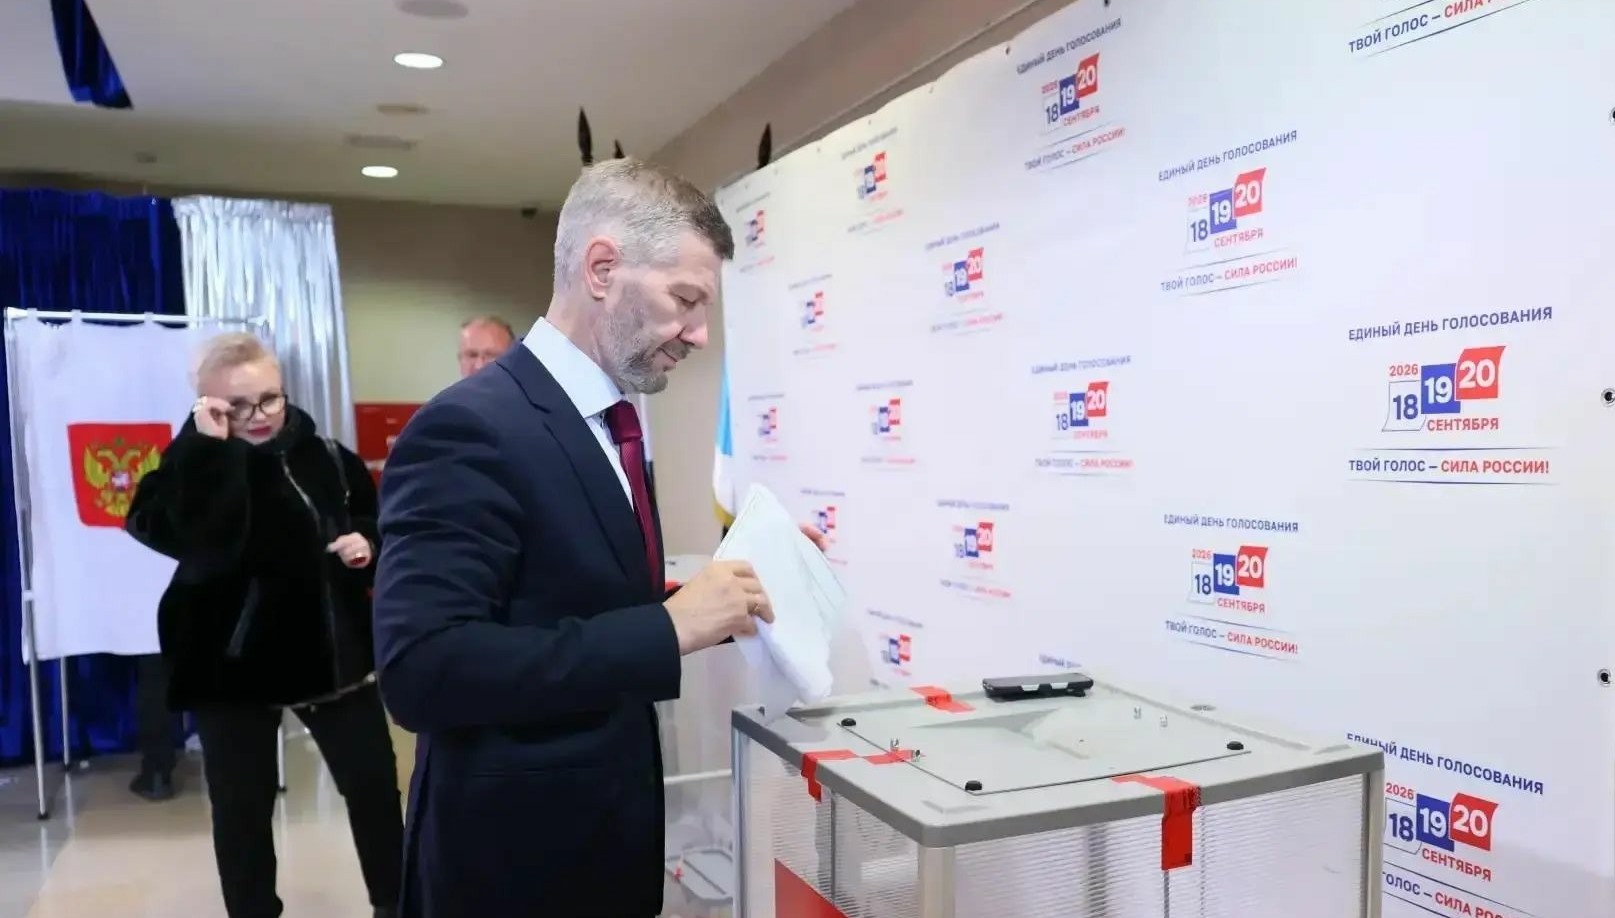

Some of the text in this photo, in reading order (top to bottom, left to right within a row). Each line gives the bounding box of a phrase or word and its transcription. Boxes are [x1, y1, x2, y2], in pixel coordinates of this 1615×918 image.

[1046, 46, 1066, 62] ДЕНЬ
[1066, 18, 1122, 52] ГОЛОСОВАНИЯ
[1348, 29, 1382, 53] ТВОЙ
[1384, 14, 1429, 41] ГОЛОС
[1045, 65, 1096, 125] 18 19 20
[1158, 129, 1298, 182] ЕДИНЫЙ ДЕНЬ ГОЛОСОВАНИЯ
[1190, 180, 1261, 243] 18 19 20
[1214, 227, 1264, 248] СЕНТЯБРЯ
[968, 256, 982, 276] 20
[1160, 276, 1183, 292] ТВОЙ
[1184, 272, 1214, 288] ГОЛОС
[1224, 266, 1251, 281] СИЛА
[1252, 257, 1298, 276] РОССИИ!
[1348, 306, 1553, 341] ЕДИНЫЙ ДЕНЬ ГОЛОСОВАНИЯ
[1388, 362, 1419, 378] 2026
[1392, 358, 1496, 421] 18 19 20
[1055, 413, 1068, 431] 18
[1070, 400, 1085, 421] 19
[1087, 389, 1105, 411] 20
[1426, 417, 1499, 432] СЕНТЯБРЯ
[1348, 456, 1381, 473] ТВОЙ
[1383, 459, 1426, 473] ГОЛОС
[1440, 460, 1479, 474] СИЛА
[1482, 460, 1550, 475] РОССИИ!
[1163, 513, 1299, 533] ЕДИНЫЙ ДЕНЬ ГОЛОСОВАНИЯ
[1194, 554, 1263, 596] 18 19 20
[1216, 597, 1265, 613] СЕНТЯБРЯ
[1188, 624, 1217, 639] ГОЛОС
[1226, 631, 1252, 646] СИЛА
[1254, 637, 1299, 654] РОССИИ!
[1400, 746, 1434, 766] ДЕНЬ
[1437, 756, 1544, 795] ГОЛОСОВАНИЯ
[1385, 782, 1415, 801] 2026
[1388, 803, 1488, 843] 18 19 20
[1421, 847, 1492, 882] СЕНТЯБРЯ
[1382, 871, 1421, 896] ОЛОС
[1435, 891, 1472, 916] СИЛА
